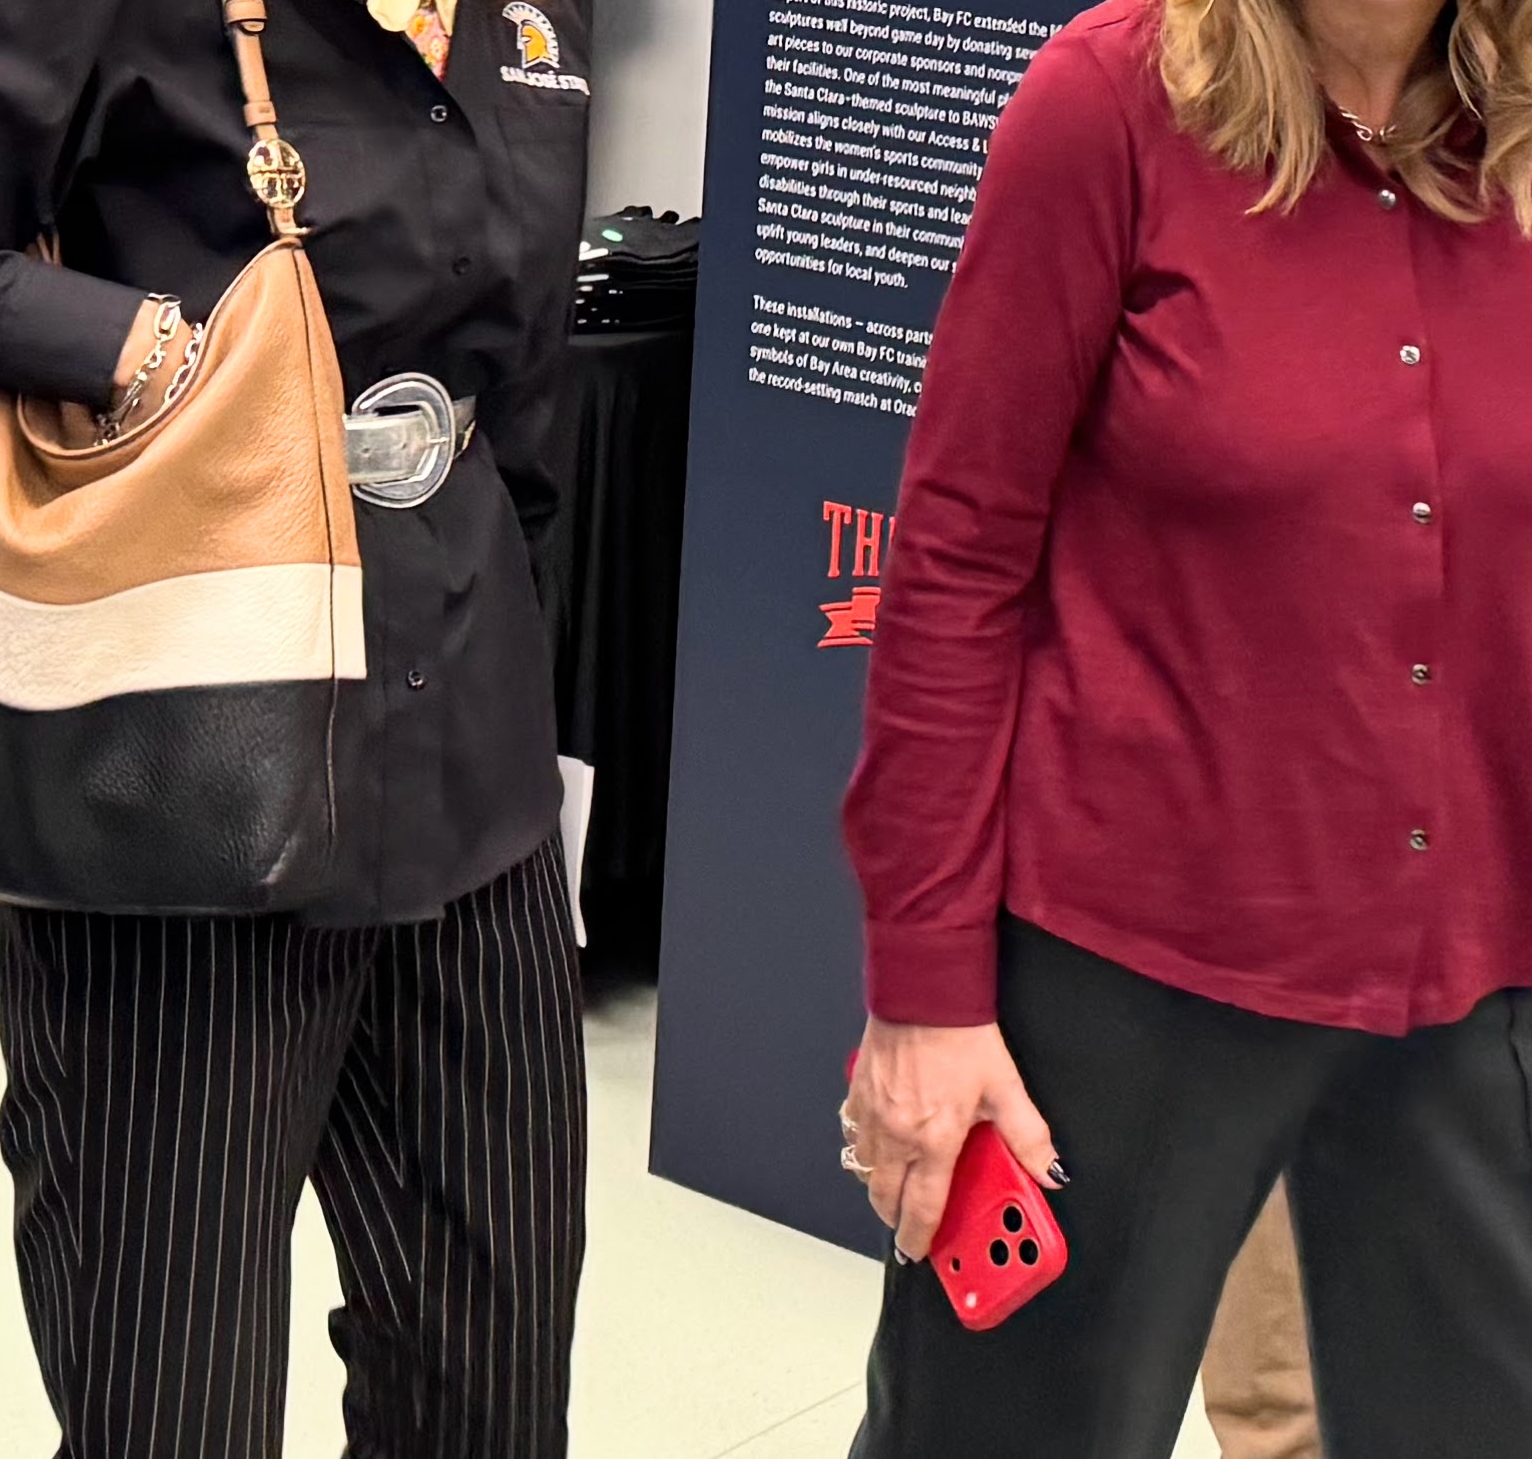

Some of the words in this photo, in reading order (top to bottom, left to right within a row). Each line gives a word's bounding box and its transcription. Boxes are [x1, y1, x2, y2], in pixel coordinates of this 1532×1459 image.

[769, 9, 823, 29] sculptures
[825, 17, 848, 32] well
[849, 19, 890, 39] beyond
[891, 28, 923, 44] game
[924, 30, 945, 51] day
[888, 3, 931, 22] project,
[933, 7, 954, 27] Bay
[973, 16, 1027, 34] extended
[1028, 21, 1048, 37] the
[767, 33, 783, 47] art
[784, 34, 820, 52] pieces
[835, 44, 854, 57] our
[855, 47, 908, 66] corporate
[910, 55, 961, 75] sponsors
[963, 63, 985, 78] and
[765, 78, 782, 95] the
[783, 81, 815, 100] Santa
[816, 86, 892, 113] Clara-themed
[894, 102, 946, 122] sculpture
[766, 54, 790, 72] their
[792, 58, 841, 80] facilities.
[843, 67, 866, 84] One
[881, 73, 900, 90] the
[901, 78, 931, 95] most
[931, 83, 996, 106] meaningful
[761, 128, 812, 148] mobilizes
[814, 134, 832, 152] the
[834, 141, 881, 160] women's
[883, 149, 919, 166] sports
[763, 103, 805, 123] mission
[806, 110, 839, 129] aligns
[841, 115, 880, 138] closely
[881, 123, 905, 139] with
[907, 129, 926, 142] our
[927, 130, 969, 150] Access
[760, 152, 809, 171] empower
[811, 159, 835, 177] girls
[849, 167, 938, 195] under-resourced
[757, 197, 788, 216] Santa
[790, 203, 818, 222] Clara
[820, 211, 871, 232] sculpture
[885, 221, 911, 239] their
[818, 184, 860, 208] through
[862, 192, 887, 210] their
[889, 199, 925, 217] sports
[927, 206, 949, 221] and
[754, 247, 825, 272] opportunities
[827, 258, 843, 275] for
[845, 262, 872, 281] local
[873, 271, 908, 288] youth.
[786, 230, 819, 249] young
[820, 232, 863, 257] leaders,
[865, 244, 886, 259] and
[887, 246, 929, 267] deepen
[930, 257, 950, 271] our
[753, 294, 785, 315] These
[786, 301, 852, 329] installations
[865, 320, 903, 340] across
[749, 345, 794, 366] symbols
[795, 353, 809, 368] of
[809, 355, 830, 376] Bay
[829, 360, 857, 379] Area
[750, 321, 772, 336] one
[772, 322, 796, 343] kept
[798, 330, 810, 344] at
[811, 334, 830, 348] our
[831, 338, 854, 354] own
[856, 340, 877, 362] Bay
[879, 345, 895, 362] FC
[748, 366, 766, 384] the
[767, 373, 841, 404] record-setting
[843, 390, 878, 408] match
[879, 397, 892, 412] at
